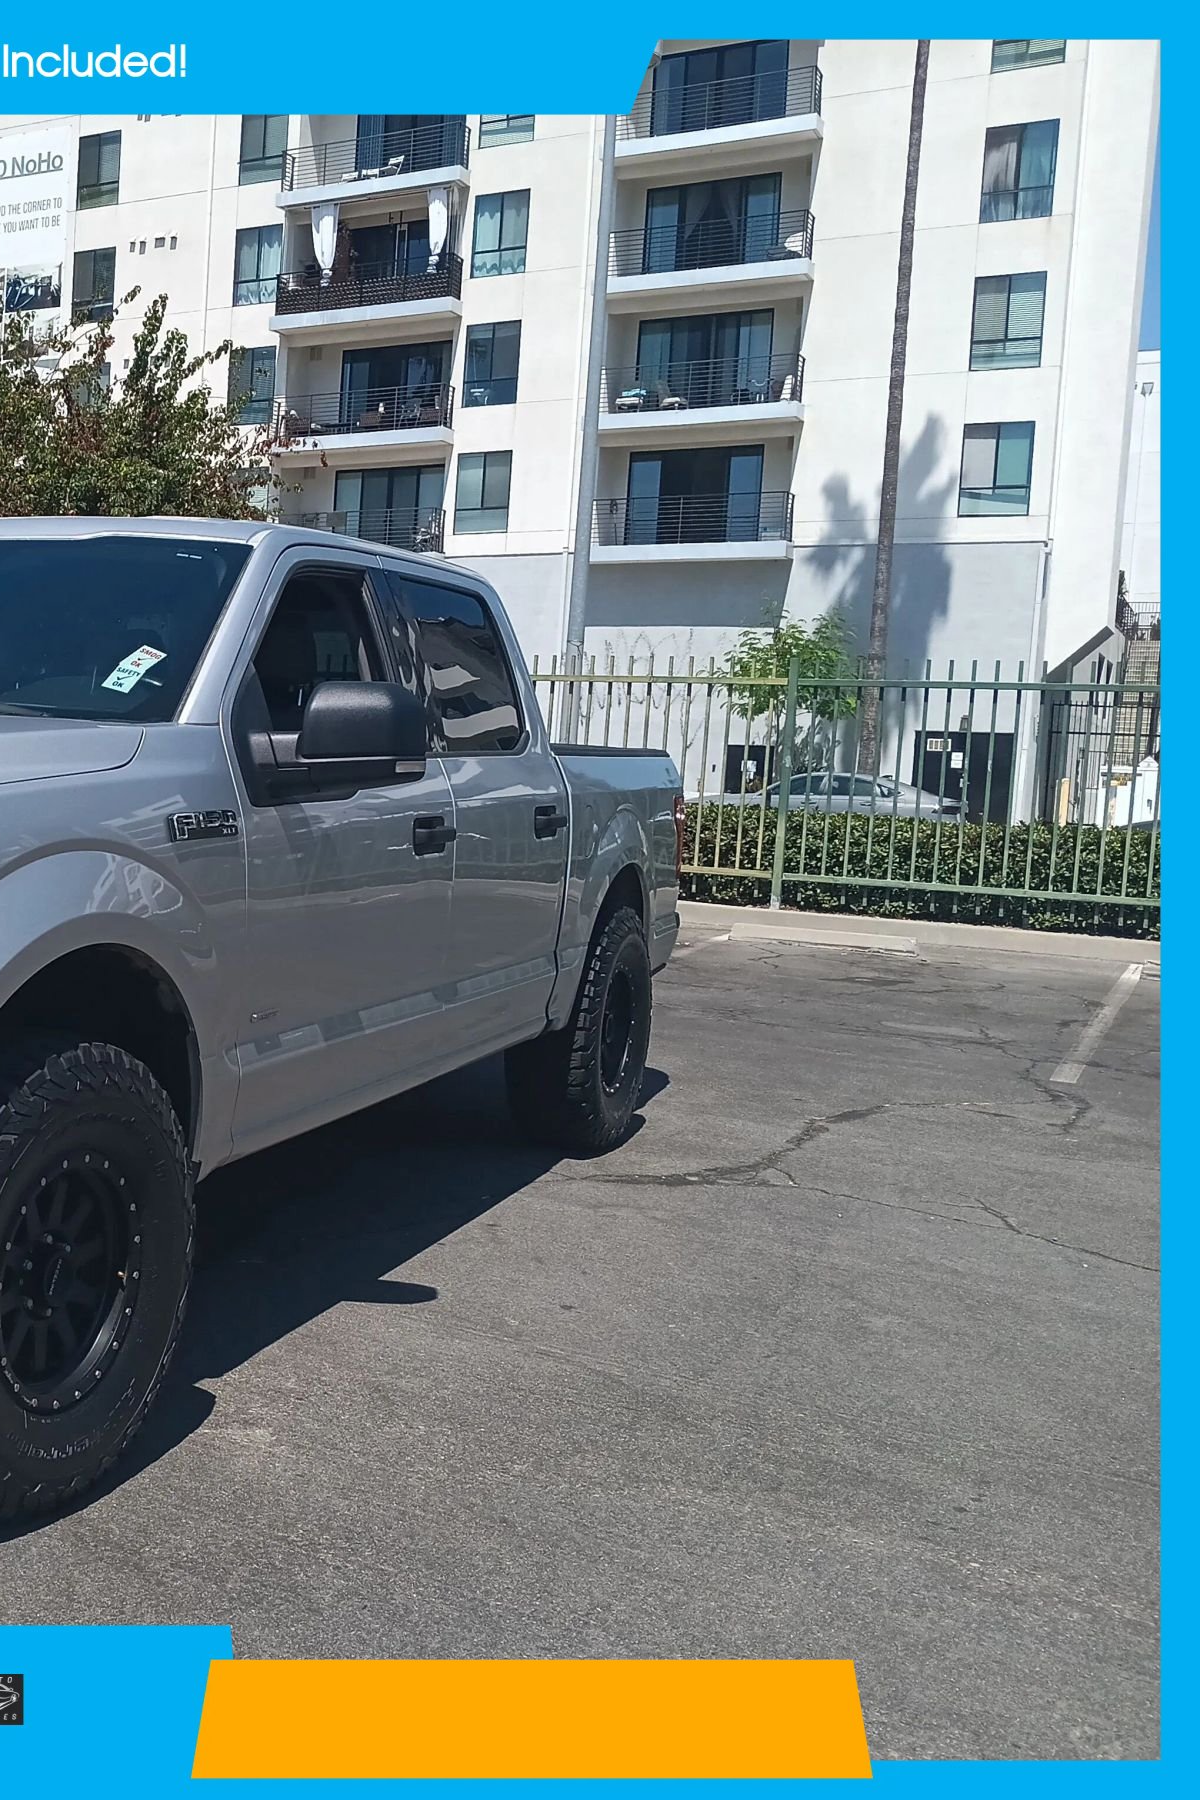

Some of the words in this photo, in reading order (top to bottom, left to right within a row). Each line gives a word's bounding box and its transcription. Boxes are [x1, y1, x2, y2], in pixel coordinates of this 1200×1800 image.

[11, 152, 63, 175] NoHo
[7, 203, 22, 216] THE
[23, 199, 52, 214] CORNER
[53, 197, 62, 209] TO
[3, 221, 17, 233] YOU
[19, 217, 39, 232] WANT
[41, 216, 50, 228] TO
[52, 215, 61, 227] BE
[140, 648, 161, 659] SMOG
[117, 667, 140, 676] SAFETY
